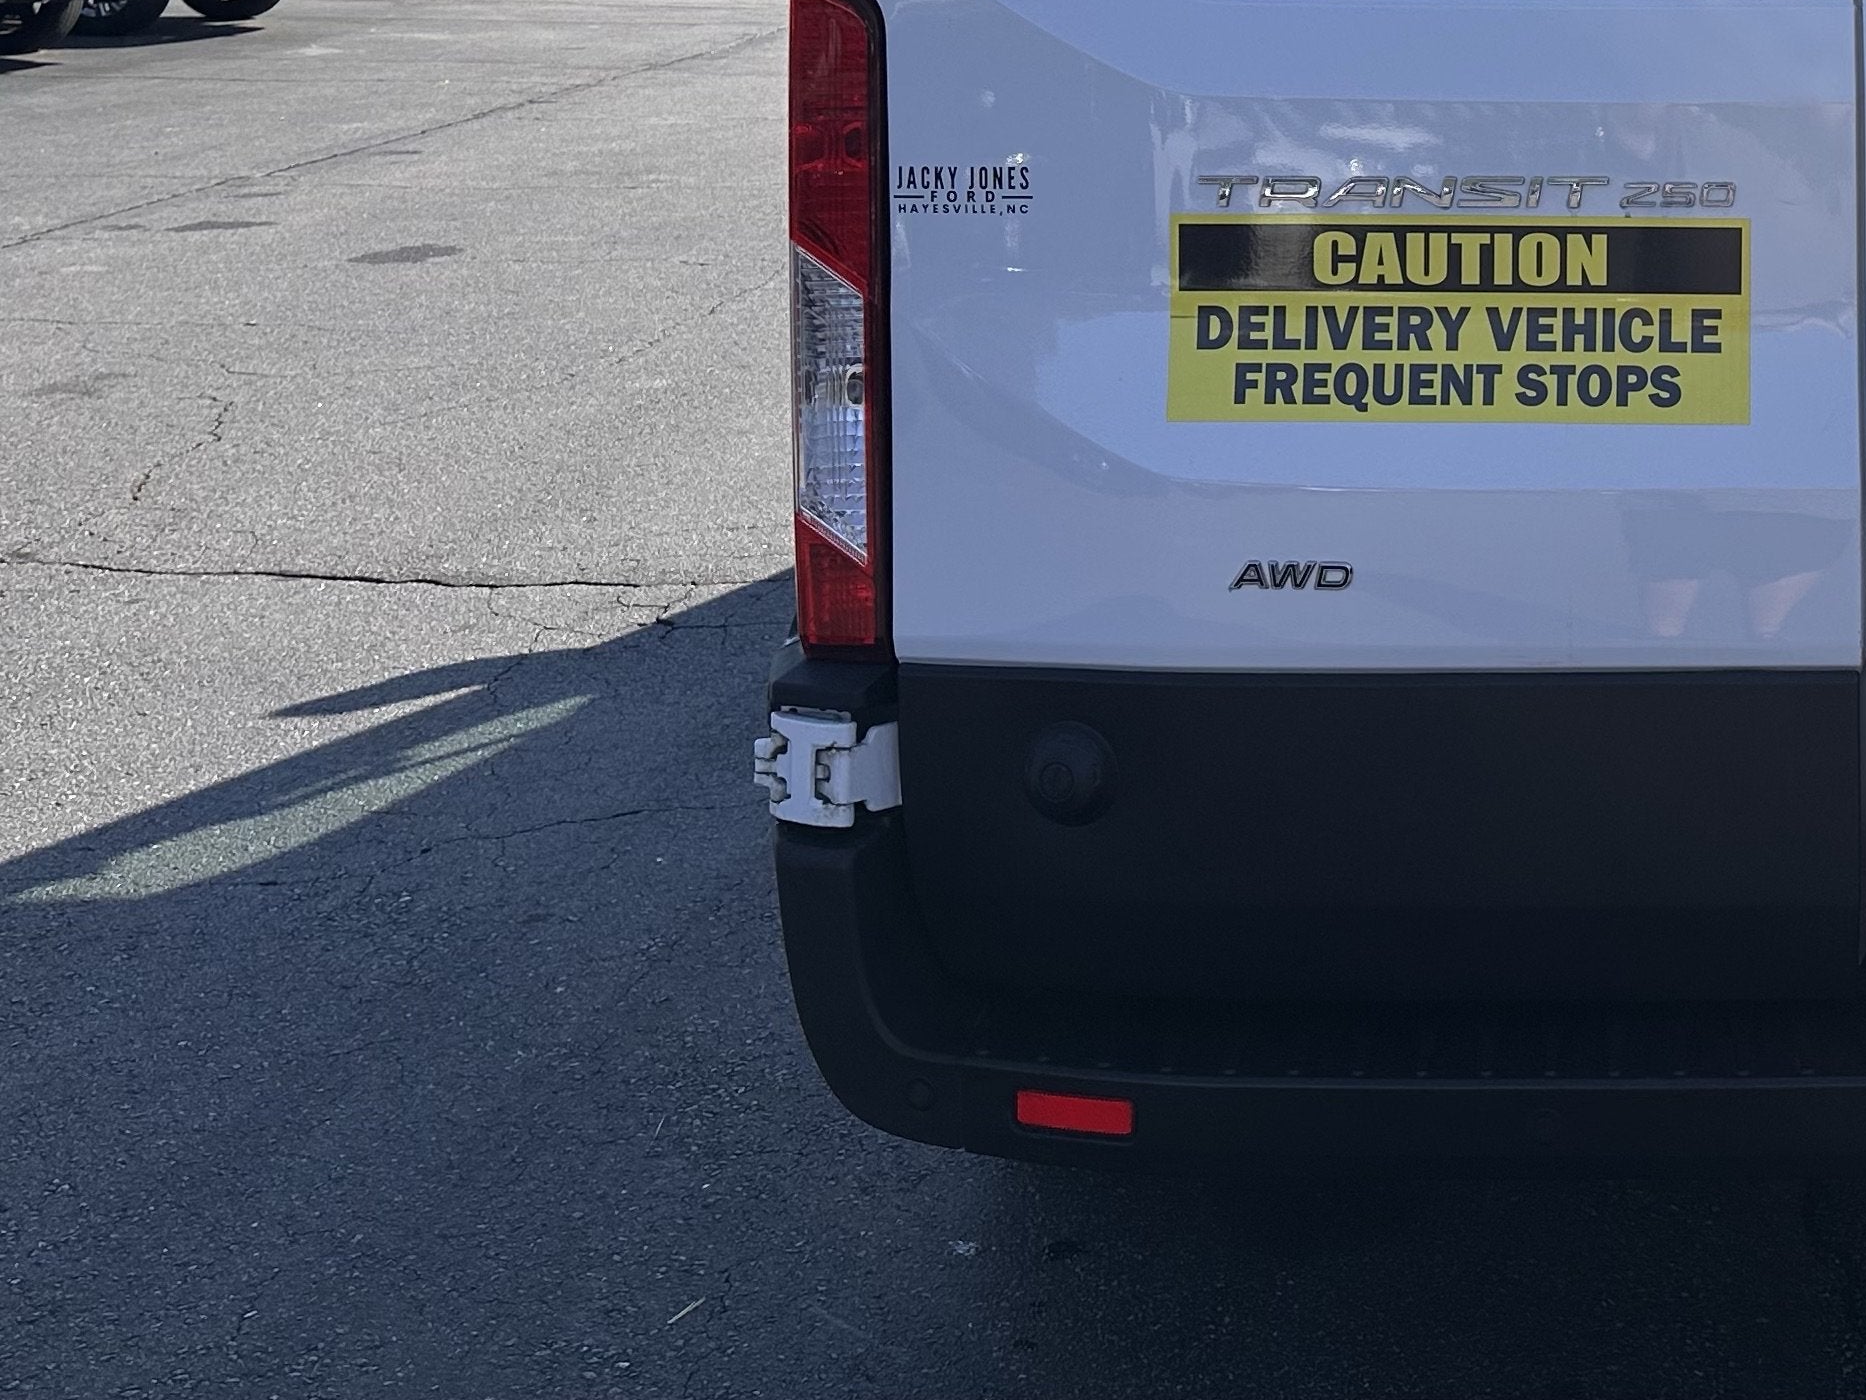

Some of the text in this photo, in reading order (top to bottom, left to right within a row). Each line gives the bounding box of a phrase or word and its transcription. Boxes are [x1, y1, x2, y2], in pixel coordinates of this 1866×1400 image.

[897, 166, 1030, 190] JACKY JONES
[1197, 175, 1737, 209] TRANSIT 250
[930, 190, 996, 203] FORD
[1313, 231, 1609, 286] CAUTION
[1196, 304, 1723, 354] DELIVERY VEHICLE
[1232, 362, 1682, 413] FREQUENT STOPS
[1228, 560, 1354, 592] AWD
